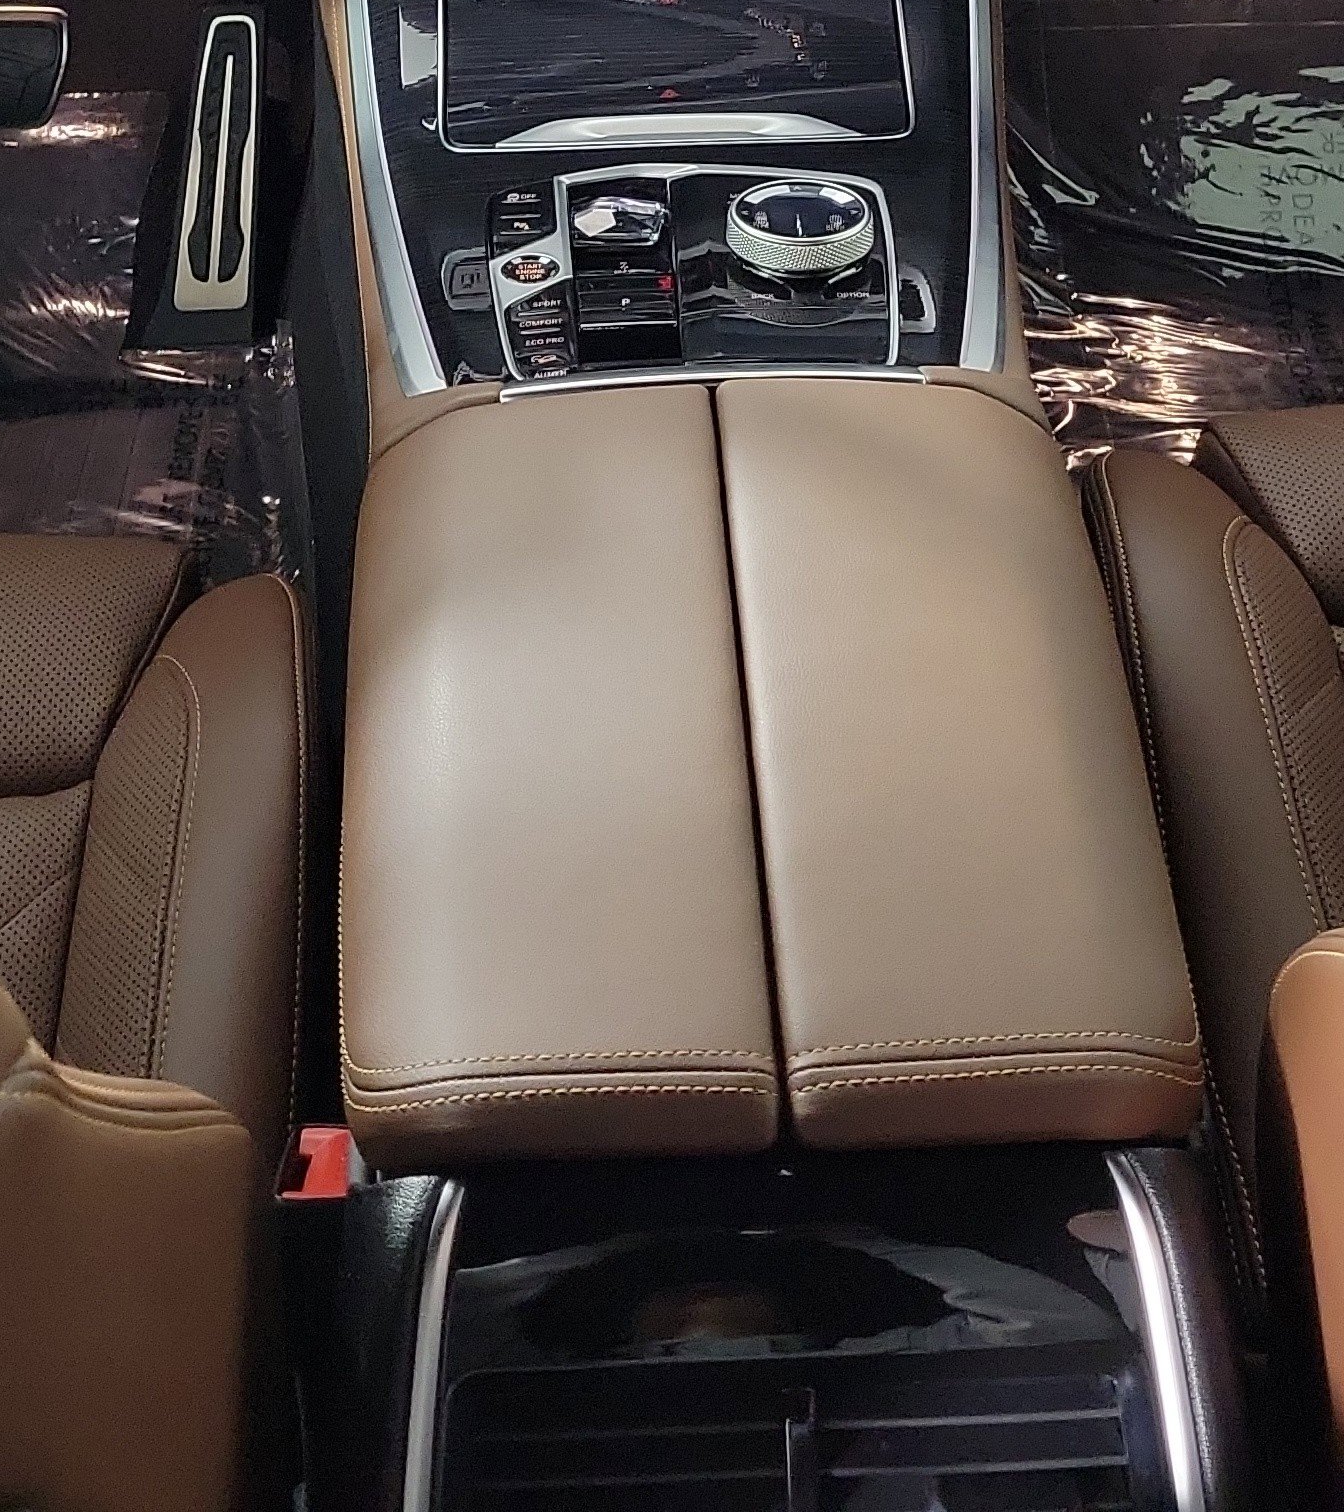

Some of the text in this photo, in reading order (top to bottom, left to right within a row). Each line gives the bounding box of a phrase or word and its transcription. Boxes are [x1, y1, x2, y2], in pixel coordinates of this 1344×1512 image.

[532, 299, 562, 308] SPORT
[519, 317, 564, 328] COMFORT
[525, 336, 565, 346] ECO PRO
